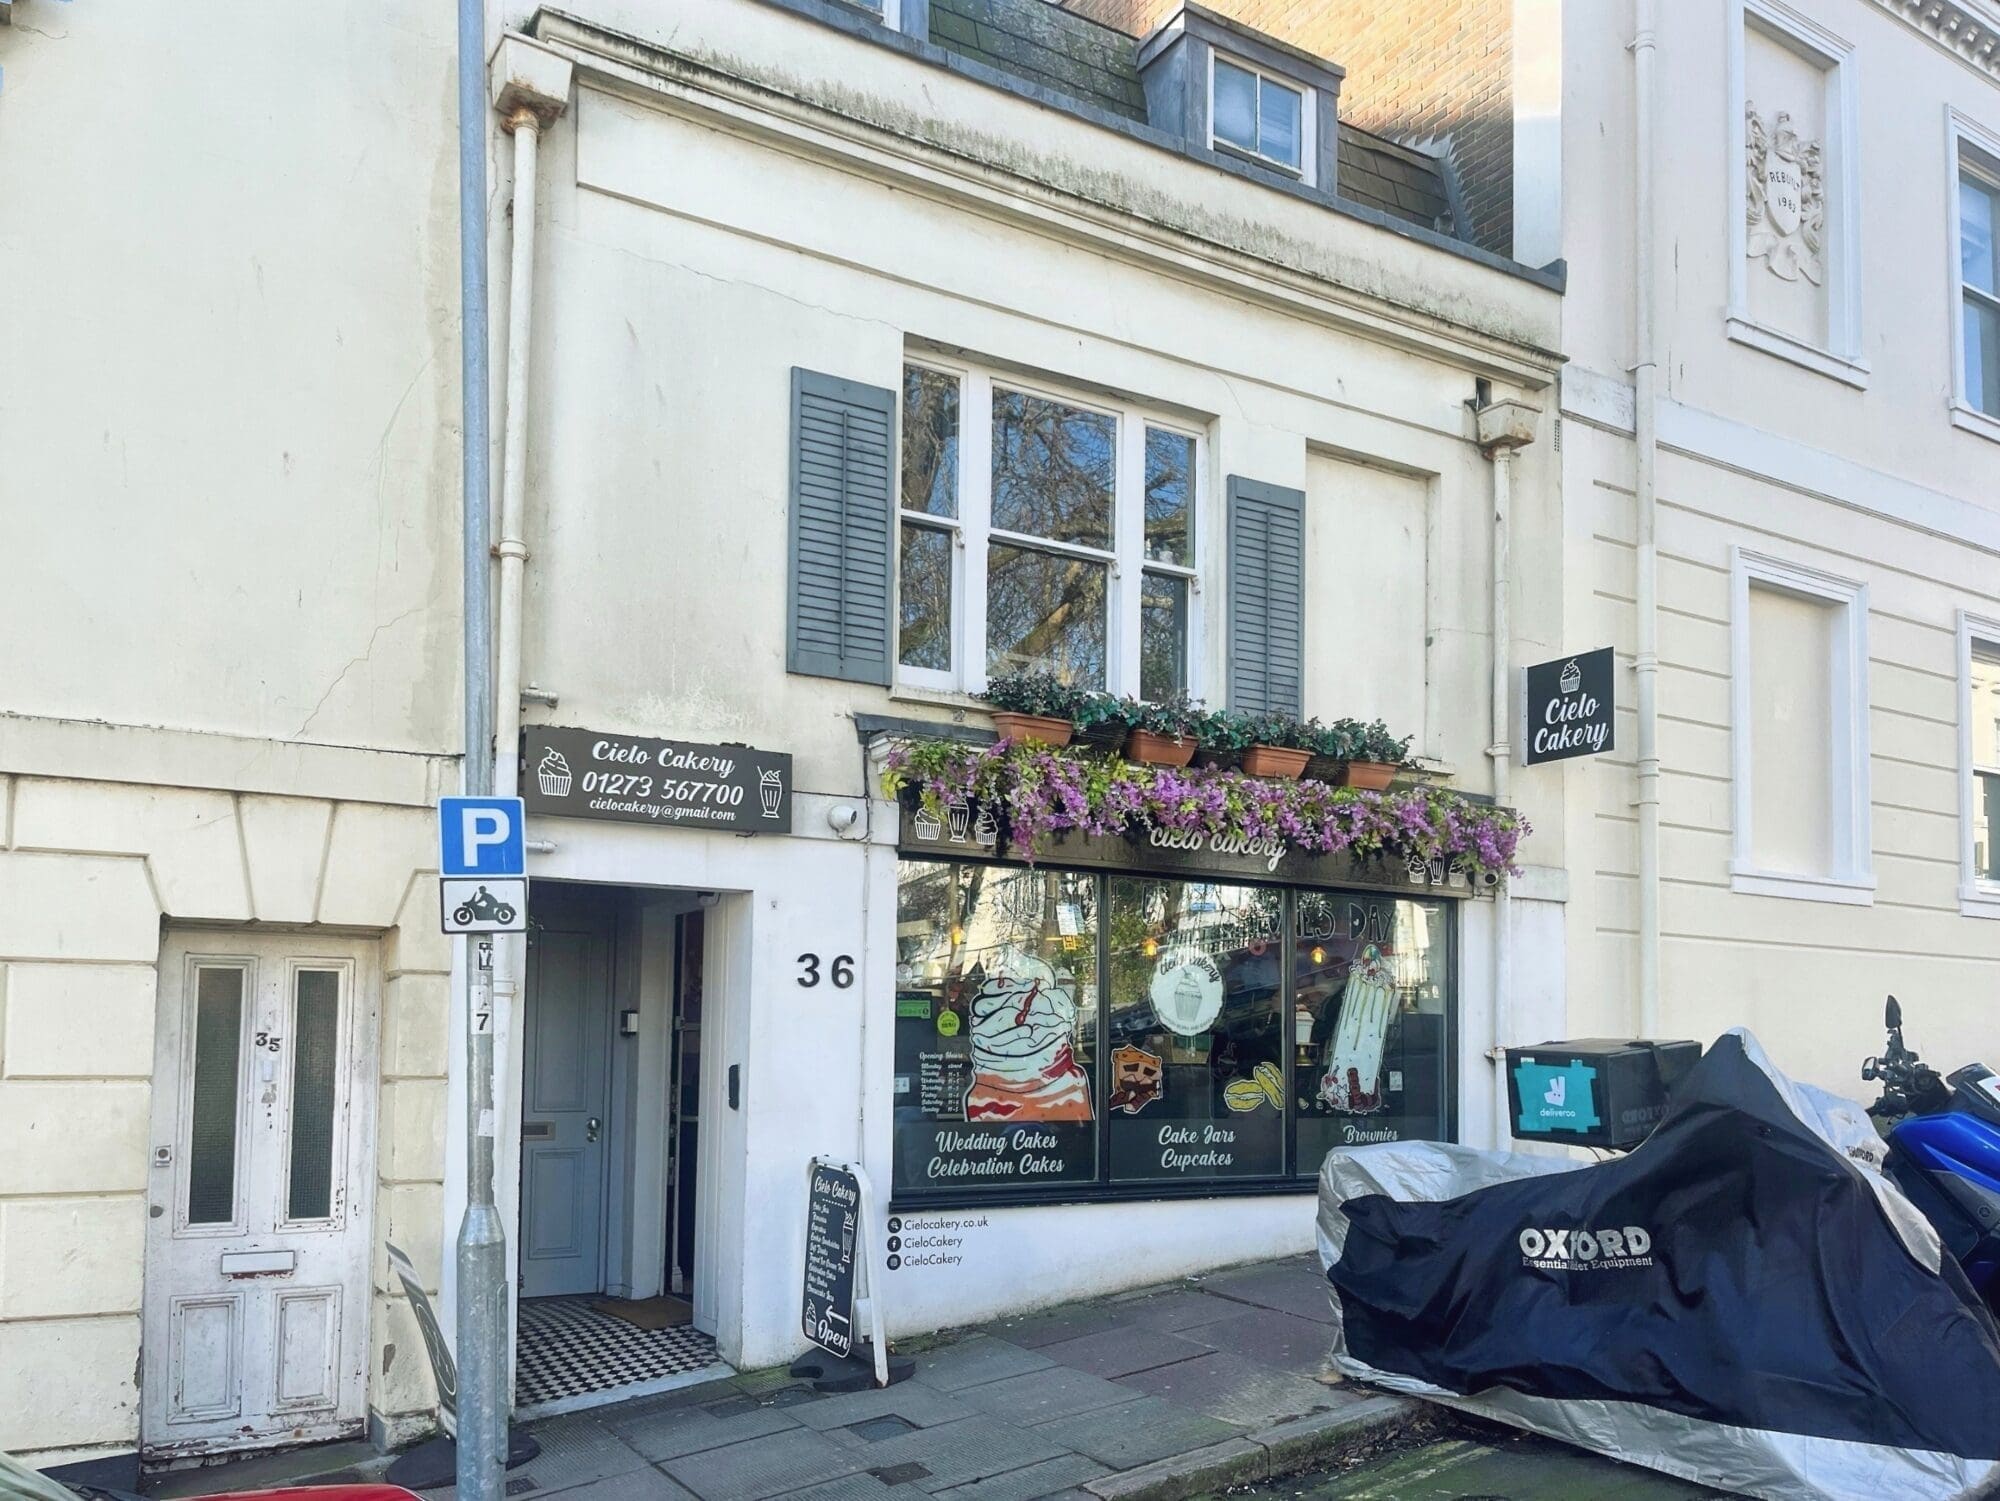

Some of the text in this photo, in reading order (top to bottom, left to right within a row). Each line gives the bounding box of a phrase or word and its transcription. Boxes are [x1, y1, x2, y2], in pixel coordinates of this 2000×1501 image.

[1545, 692, 1600, 725] Cielo
[1534, 722, 1609, 754] Cakery
[592, 740, 736, 779] Cielo Cakery
[582, 771, 744, 806] 01273 567700
[462, 807, 510, 868] P
[797, 952, 855, 989] 36
[476, 1013, 489, 1031] 7
[255, 1032, 283, 1052] 35
[1539, 1108, 1576, 1118] deliveroo
[935, 1129, 1058, 1155] Wedding Cakes
[1158, 1125, 1236, 1145] Cake Jars
[1342, 1125, 1399, 1144] Brownies
[927, 1153, 1065, 1178] Celebration Cakes
[1160, 1148, 1234, 1172] Cupcakes
[831, 1180, 857, 1207] Cakery
[904, 1215, 989, 1231] Cielocakery.co.uk
[904, 1234, 963, 1249] CieloCakery
[904, 1252, 963, 1267] CieloCakery
[1590, 1256, 1653, 1270] Equipment
[817, 1319, 850, 1350] Open
